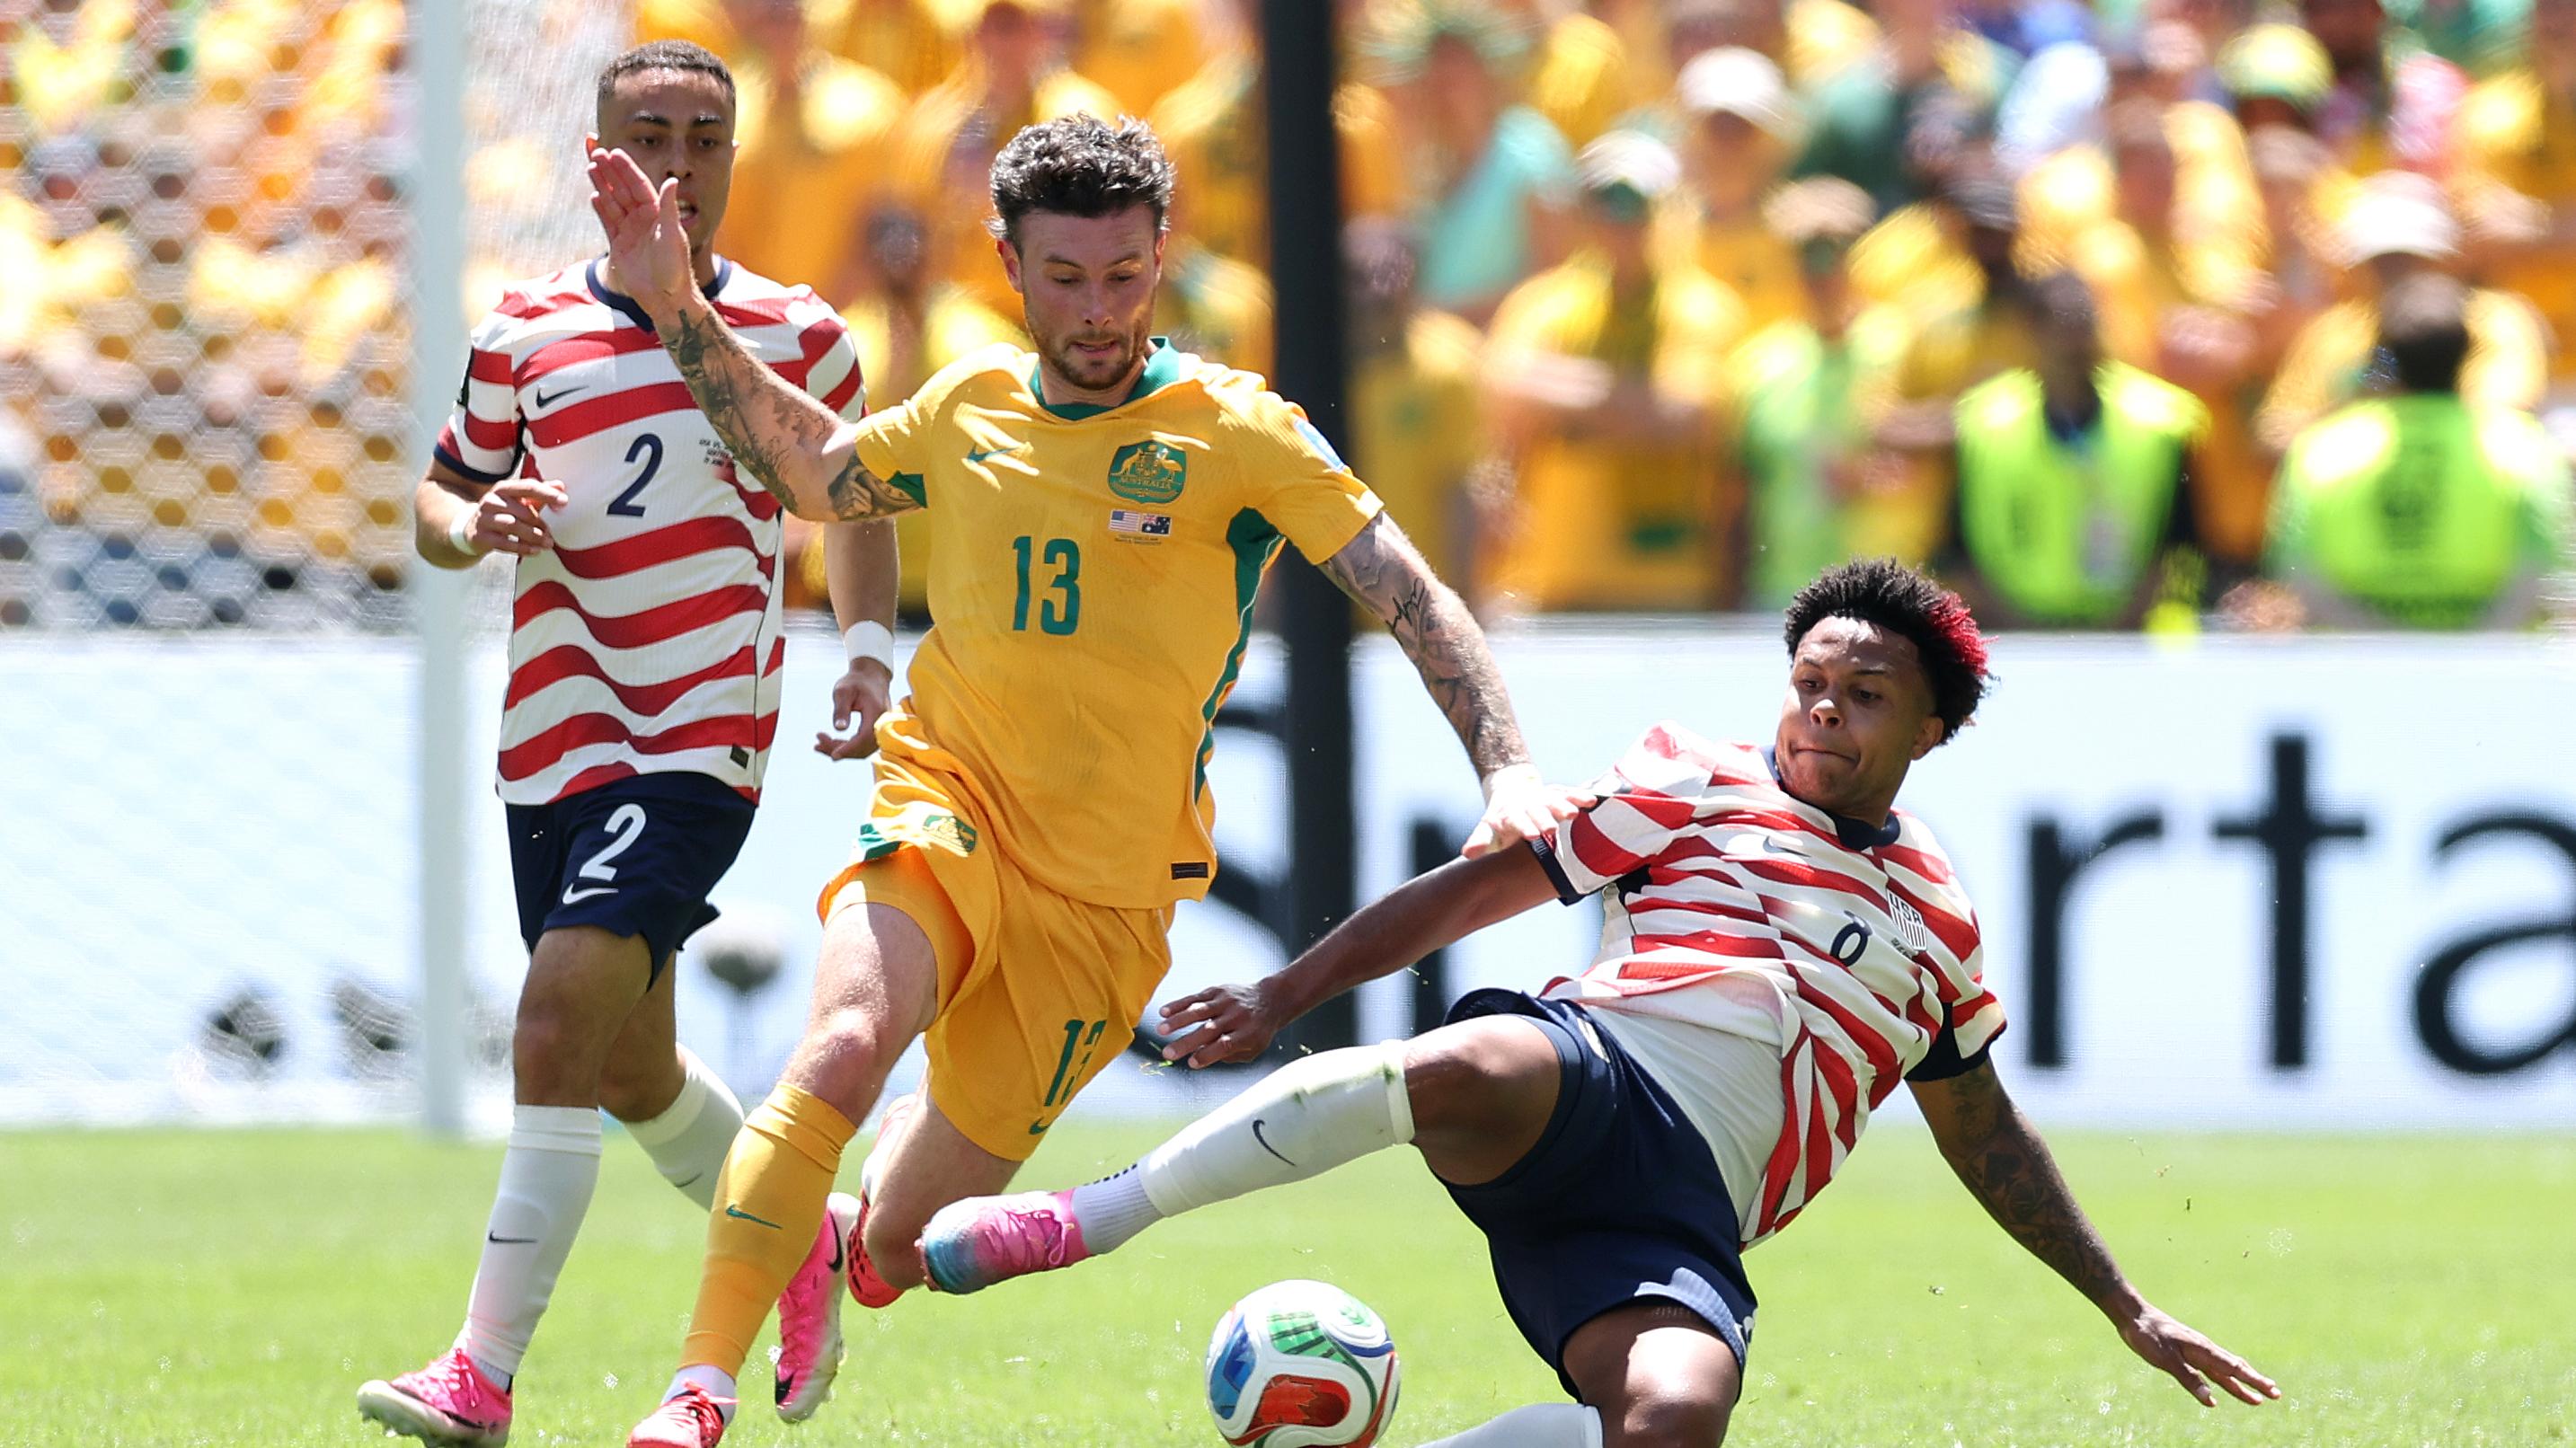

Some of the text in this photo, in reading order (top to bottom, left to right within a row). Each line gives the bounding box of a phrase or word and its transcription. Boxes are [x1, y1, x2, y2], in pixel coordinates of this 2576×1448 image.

[606, 433, 664, 517] 2
[1012, 535, 1080, 636] 13
[578, 803, 647, 882] 2
[1889, 892, 1922, 925] USA
